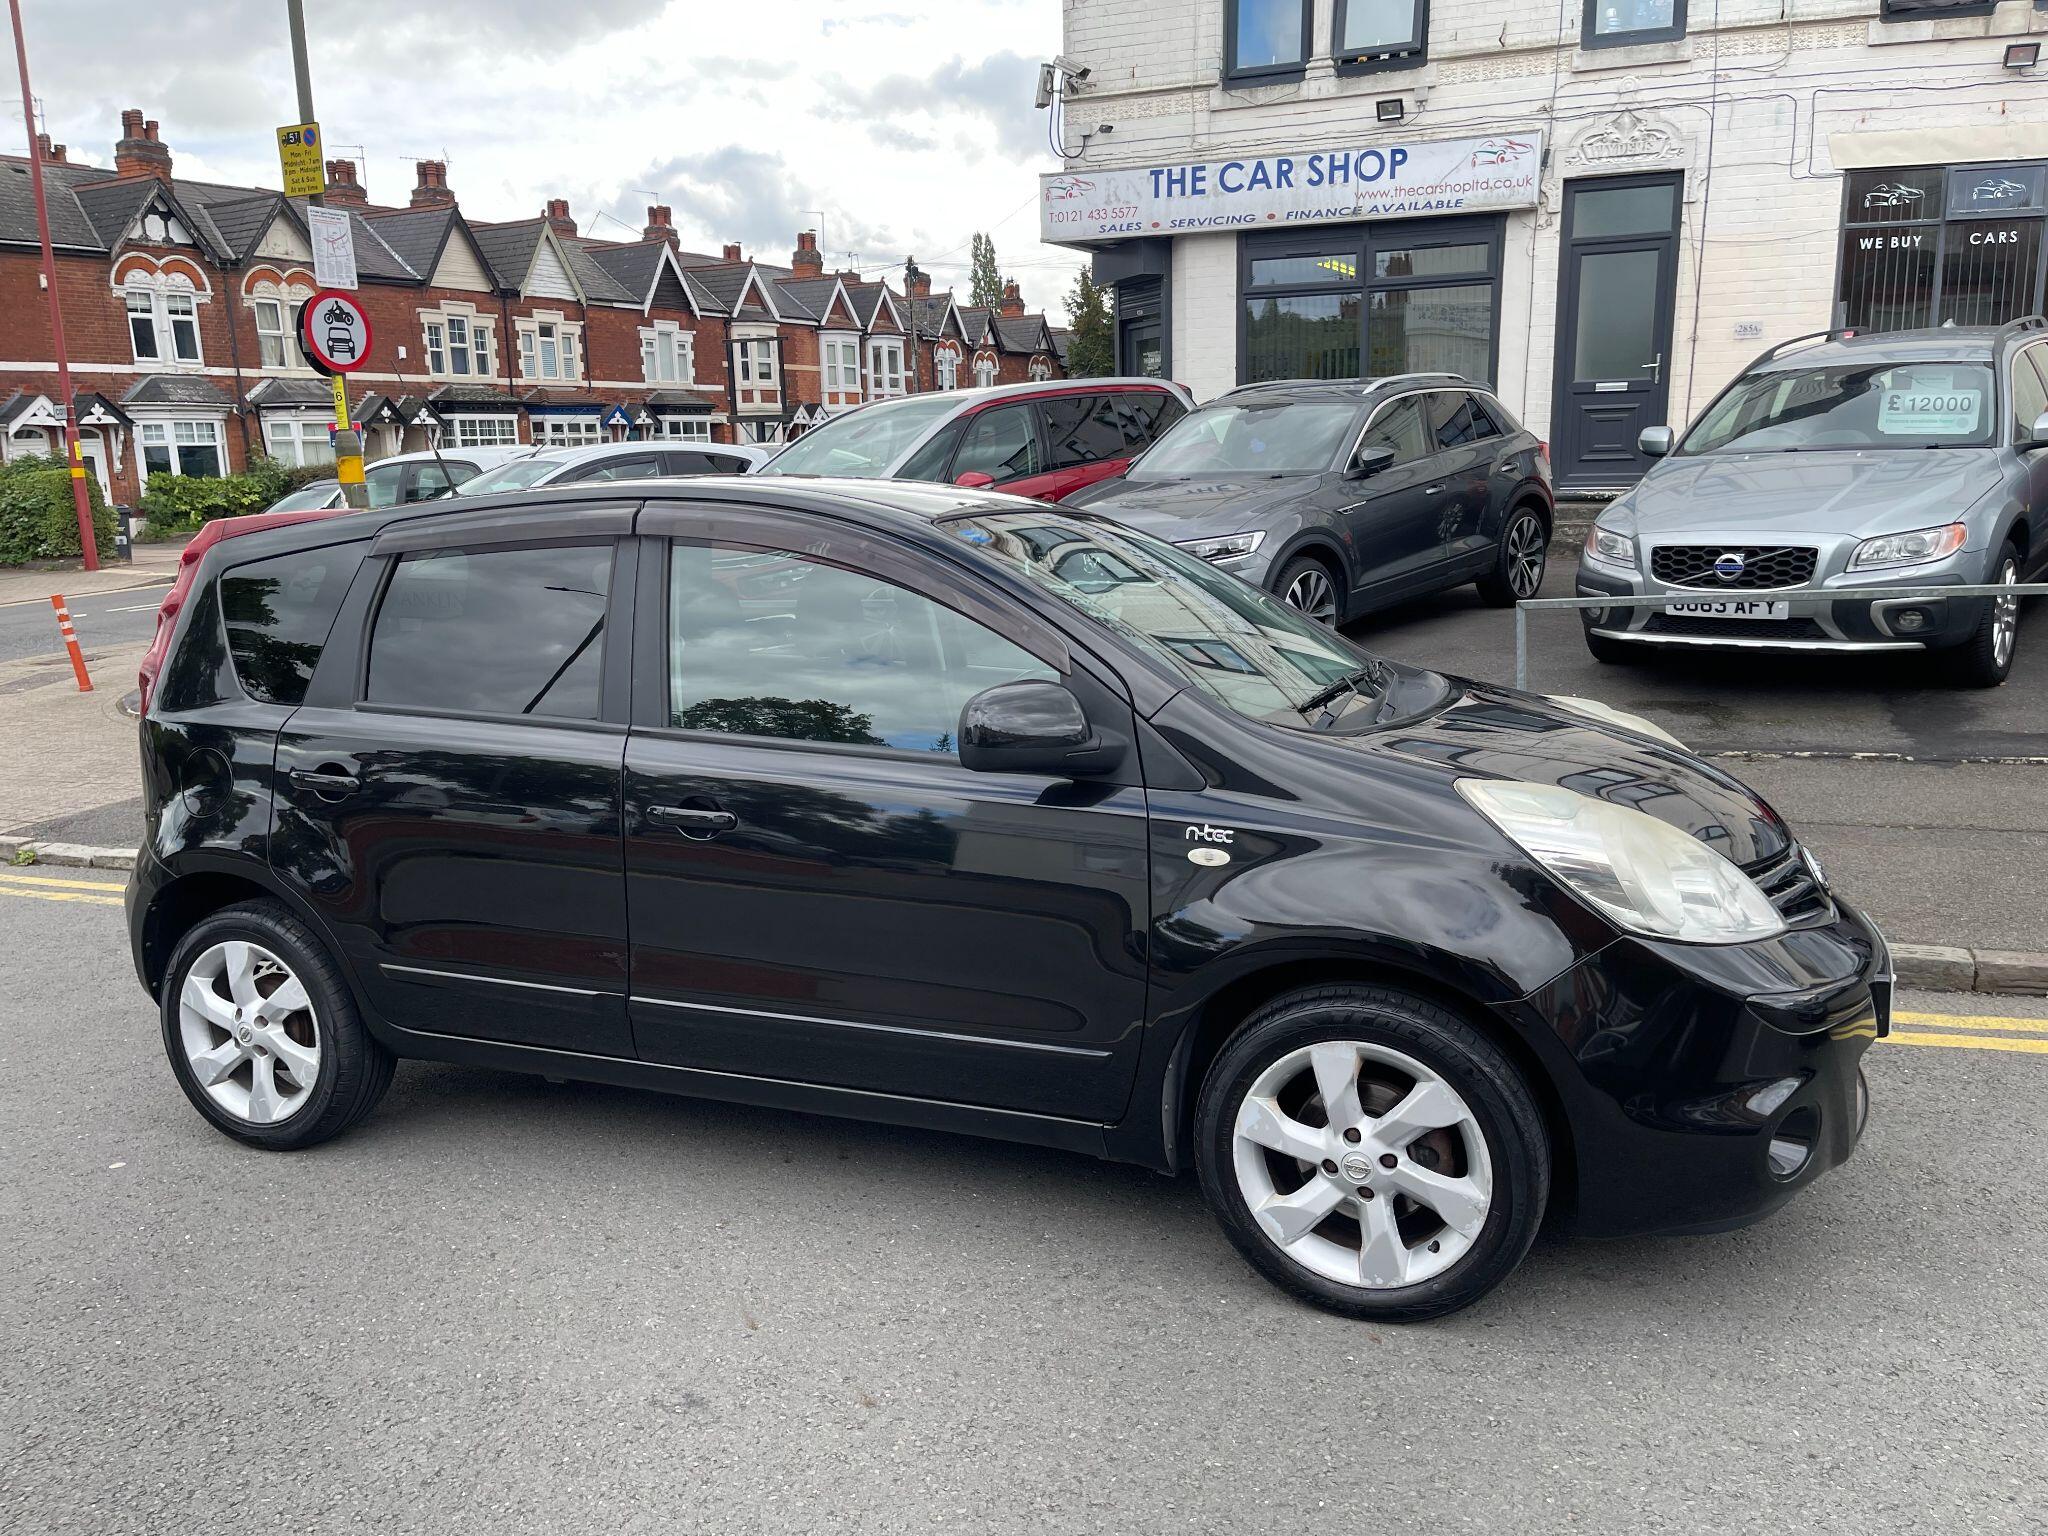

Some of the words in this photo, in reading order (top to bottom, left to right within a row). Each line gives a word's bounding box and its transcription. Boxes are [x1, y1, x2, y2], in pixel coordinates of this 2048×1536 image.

[1150, 165, 1206, 199] THE
[1218, 158, 1294, 193] CAR
[1307, 148, 1408, 187] SHOP
[1354, 175, 1533, 200] www.thecarshopltd.co.uk
[1049, 210, 1083, 224] T:0121
[1087, 208, 1108, 221] 433
[1111, 206, 1139, 219] 5577
[1099, 222, 1142, 234] SALES
[1169, 213, 1257, 229] SERVICING
[1286, 206, 1363, 220] FINANCE
[1368, 198, 1464, 214] AVAILABLE
[1859, 237, 1883, 250] WE
[1890, 235, 1922, 249] BUY
[1969, 230, 2018, 245] CARS
[1887, 394, 1901, 412] £
[1908, 396, 1972, 412] 12000
[1734, 600, 1775, 615] AFY
